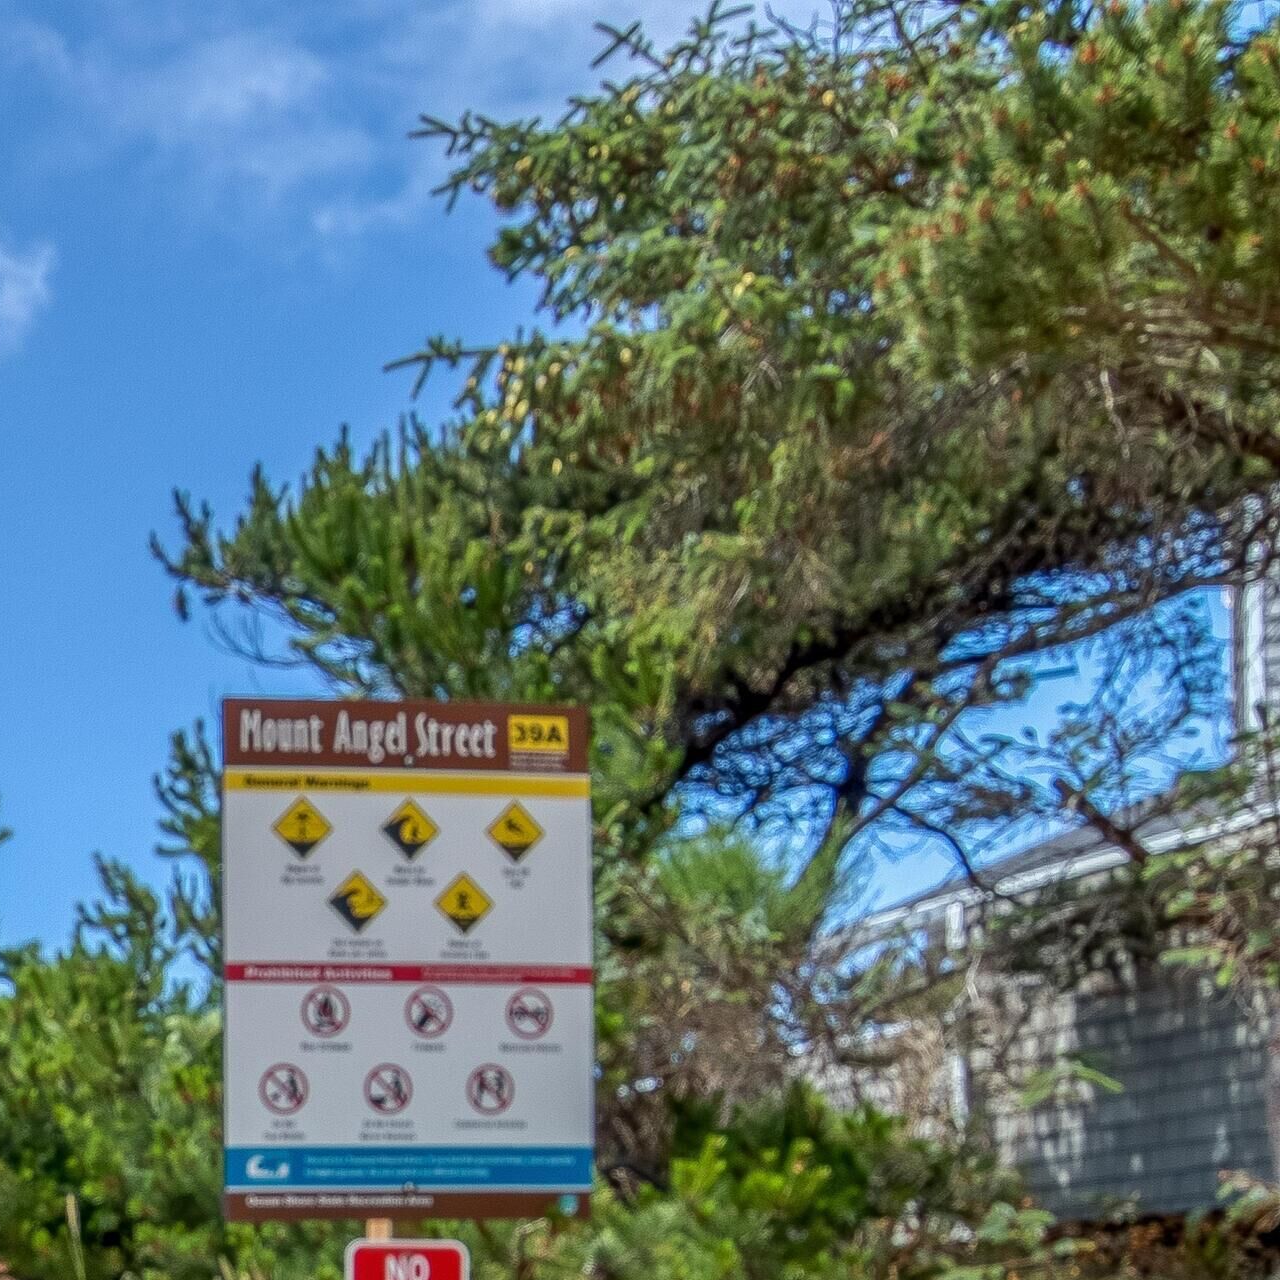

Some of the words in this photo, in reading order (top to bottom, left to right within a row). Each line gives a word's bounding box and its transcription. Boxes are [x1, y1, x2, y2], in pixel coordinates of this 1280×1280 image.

[240, 708, 324, 753] Mount
[333, 710, 407, 764] Angel
[415, 711, 497, 758] Street
[513, 722, 562, 743] 39A
